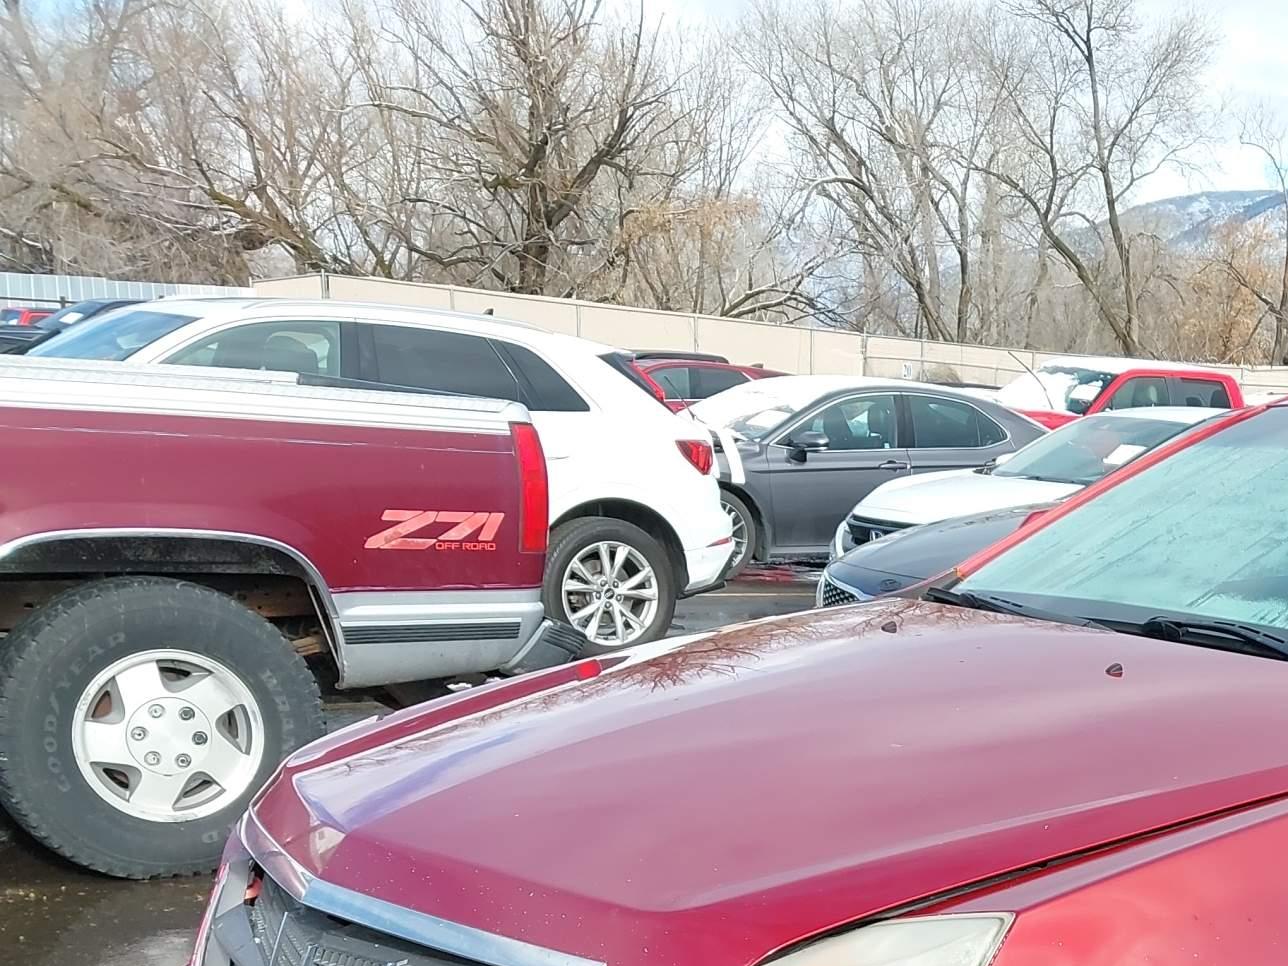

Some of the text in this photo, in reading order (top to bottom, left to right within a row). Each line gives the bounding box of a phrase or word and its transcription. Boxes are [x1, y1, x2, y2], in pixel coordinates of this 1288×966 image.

[364, 509, 506, 550] Z71
[435, 542, 497, 552] OFF ROAD
